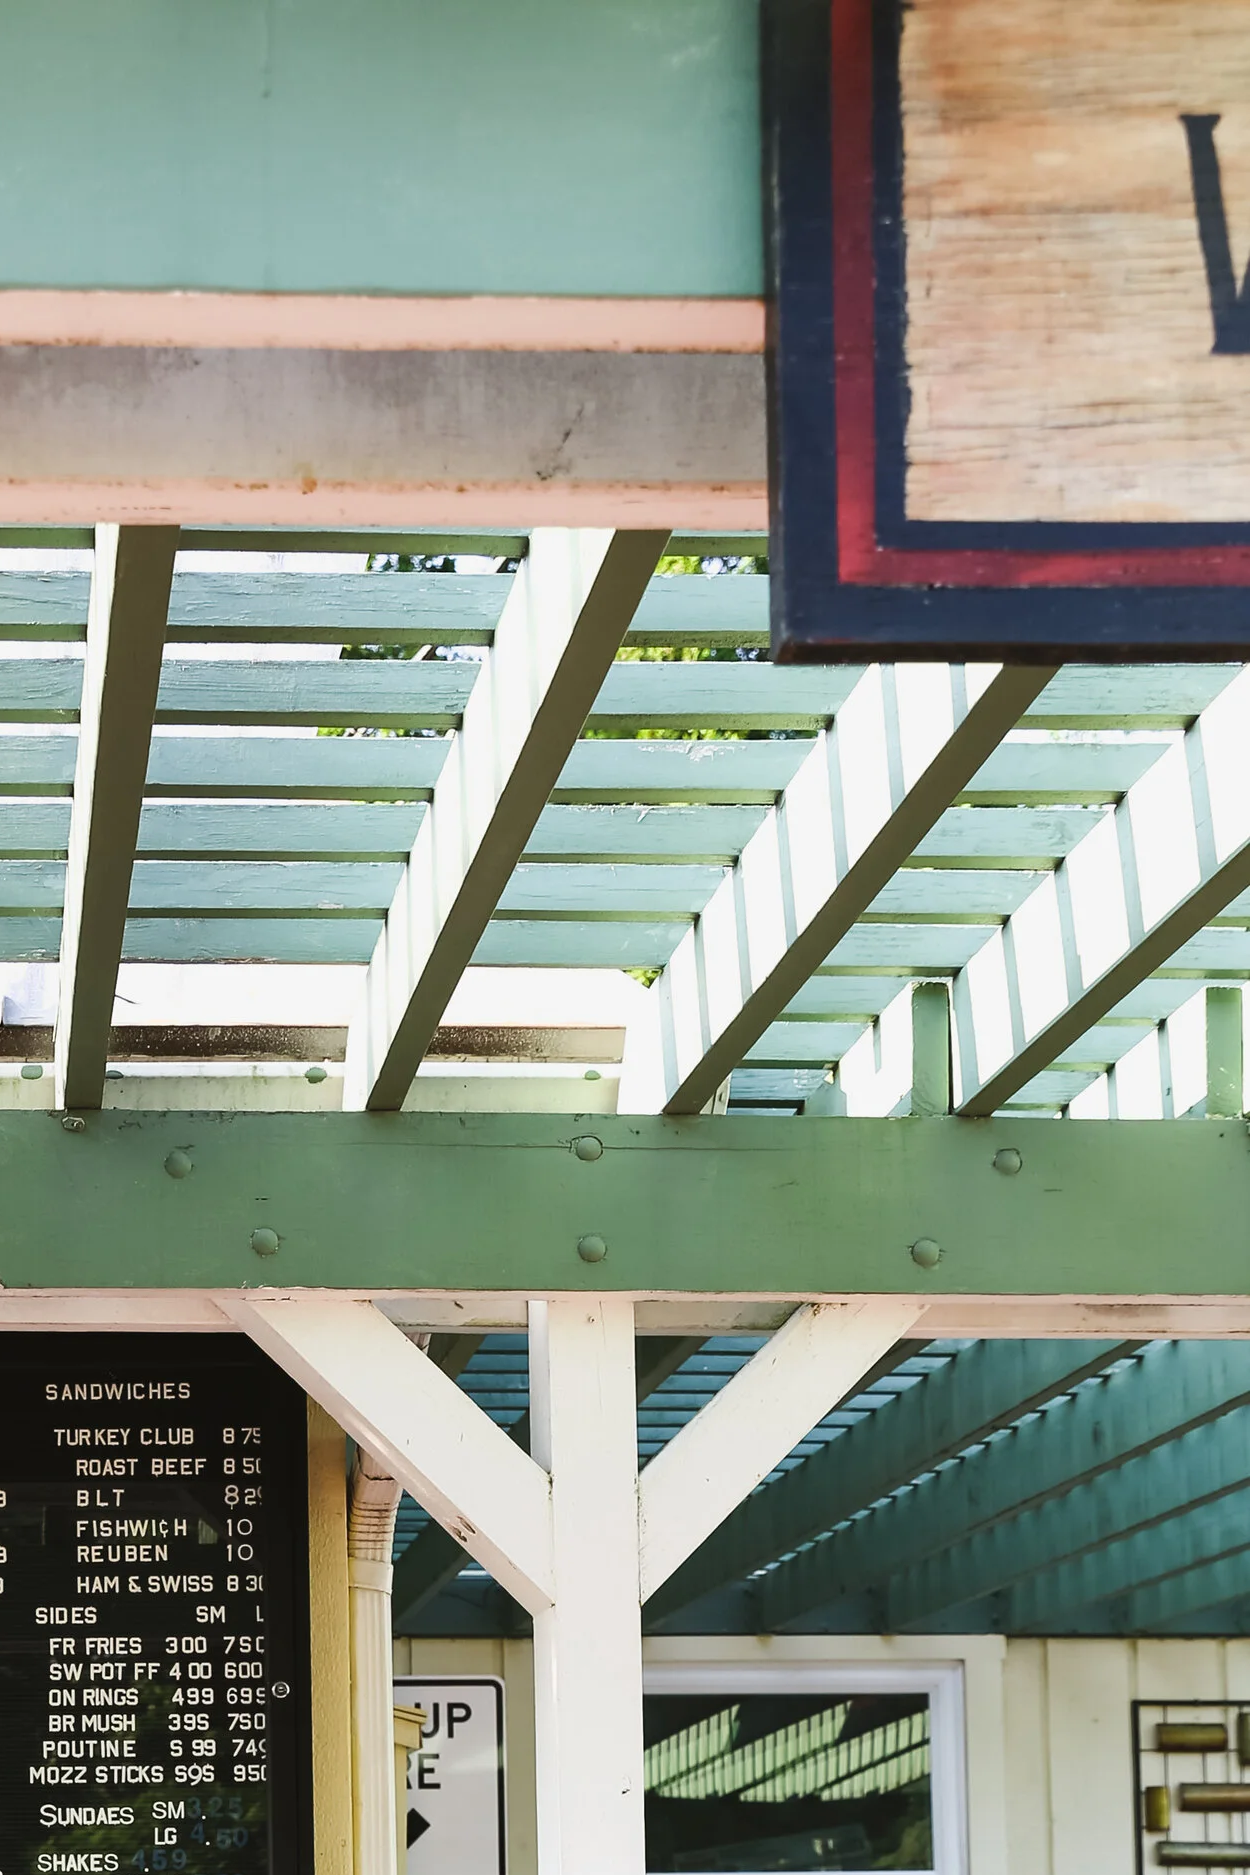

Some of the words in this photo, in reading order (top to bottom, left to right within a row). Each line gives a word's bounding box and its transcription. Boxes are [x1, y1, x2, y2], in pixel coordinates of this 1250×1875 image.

[46, 1383, 190, 1400] SANDWICHES
[54, 1429, 130, 1446] TURKEY
[141, 1428, 193, 1445] CLUB
[77, 1459, 138, 1476] ROAST
[152, 1459, 206, 1476] BEEF
[77, 1519, 186, 1538] FISHWICH
[78, 1545, 167, 1562] REUBEN
[77, 1576, 119, 1593] HAM
[129, 1576, 141, 1592] &
[148, 1576, 213, 1593] SWISS
[36, 1607, 96, 1624] SIDES
[197, 1606, 225, 1623] SM
[50, 1638, 75, 1655] FR
[86, 1637, 141, 1655] FRIES
[50, 1663, 83, 1681] SW
[90, 1662, 126, 1680] POT
[135, 1663, 160, 1680] FF
[225, 1662, 262, 1678] 600
[49, 1689, 75, 1706] ON
[83, 1688, 138, 1706] RINGS
[172, 1688, 213, 1706] 499
[49, 1715, 75, 1732] BR
[82, 1714, 135, 1733] MUSH
[43, 1740, 136, 1759] POUTINE
[30, 1766, 87, 1785] MOZZ
[96, 1766, 163, 1784] STICKS
[40, 1804, 134, 1827] SUNDAES
[152, 1801, 184, 1819] SM
[155, 1827, 176, 1845] LG
[38, 1854, 118, 1872] SHAKES
